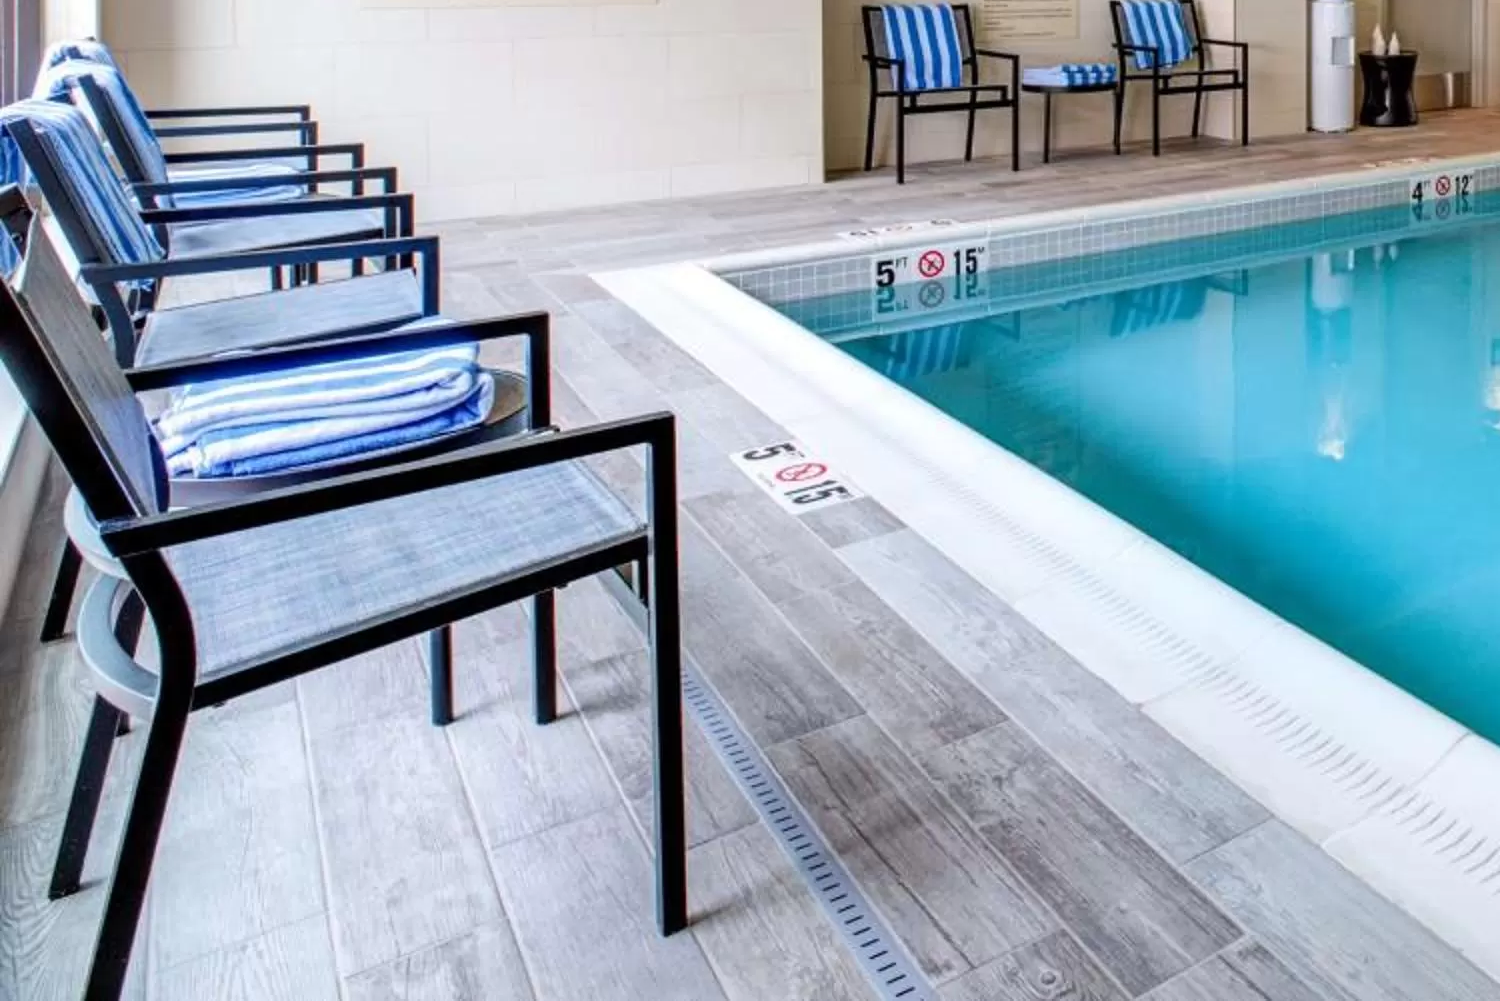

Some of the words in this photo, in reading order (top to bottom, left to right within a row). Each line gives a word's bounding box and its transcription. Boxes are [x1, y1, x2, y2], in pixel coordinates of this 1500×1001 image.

[1412, 182, 1423, 203] 4
[876, 259, 895, 288] 5
[896, 256, 909, 269] FT
[743, 442, 797, 461] 5
